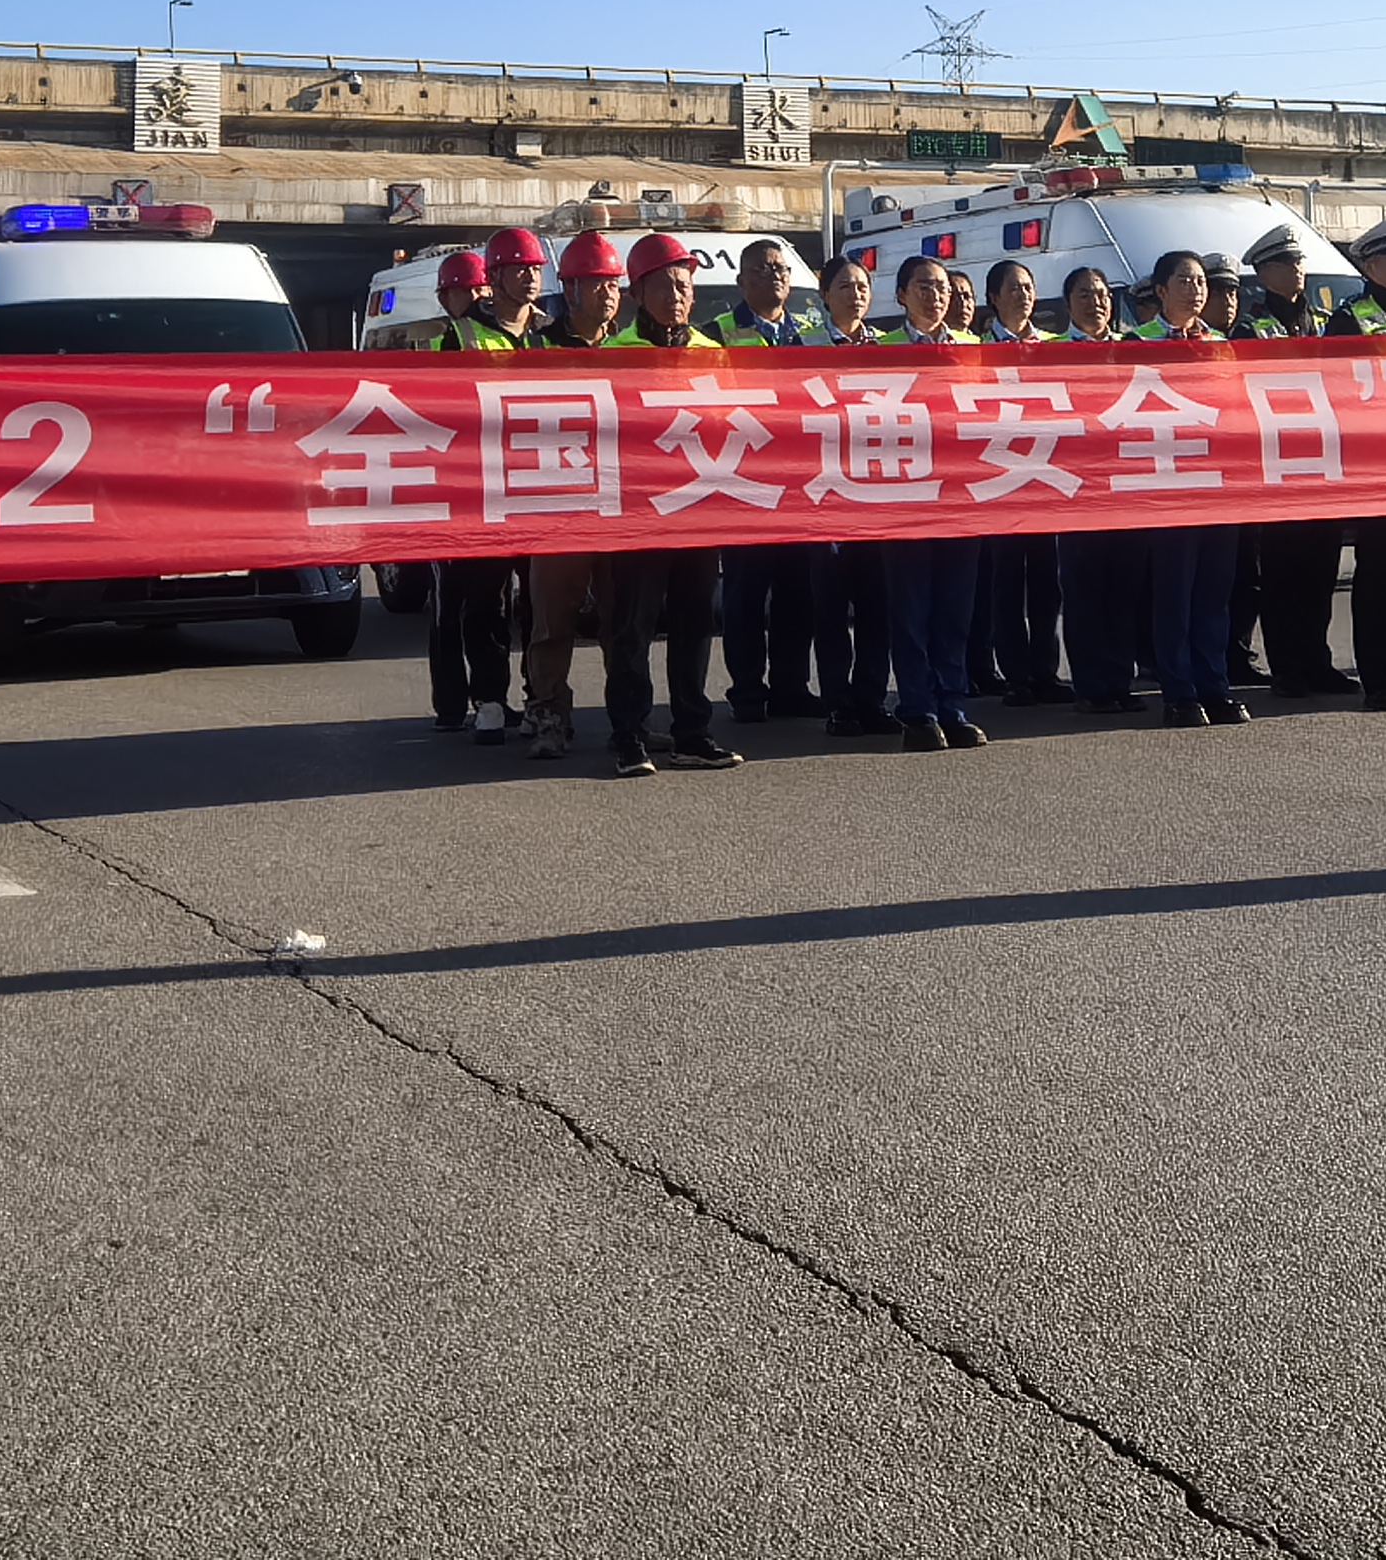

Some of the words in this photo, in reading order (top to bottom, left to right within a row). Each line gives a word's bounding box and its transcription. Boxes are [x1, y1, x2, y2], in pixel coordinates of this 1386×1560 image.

[750, 90, 802, 143] 水
[146, 130, 208, 149] JIAN
[748, 146, 800, 162] SHUI
